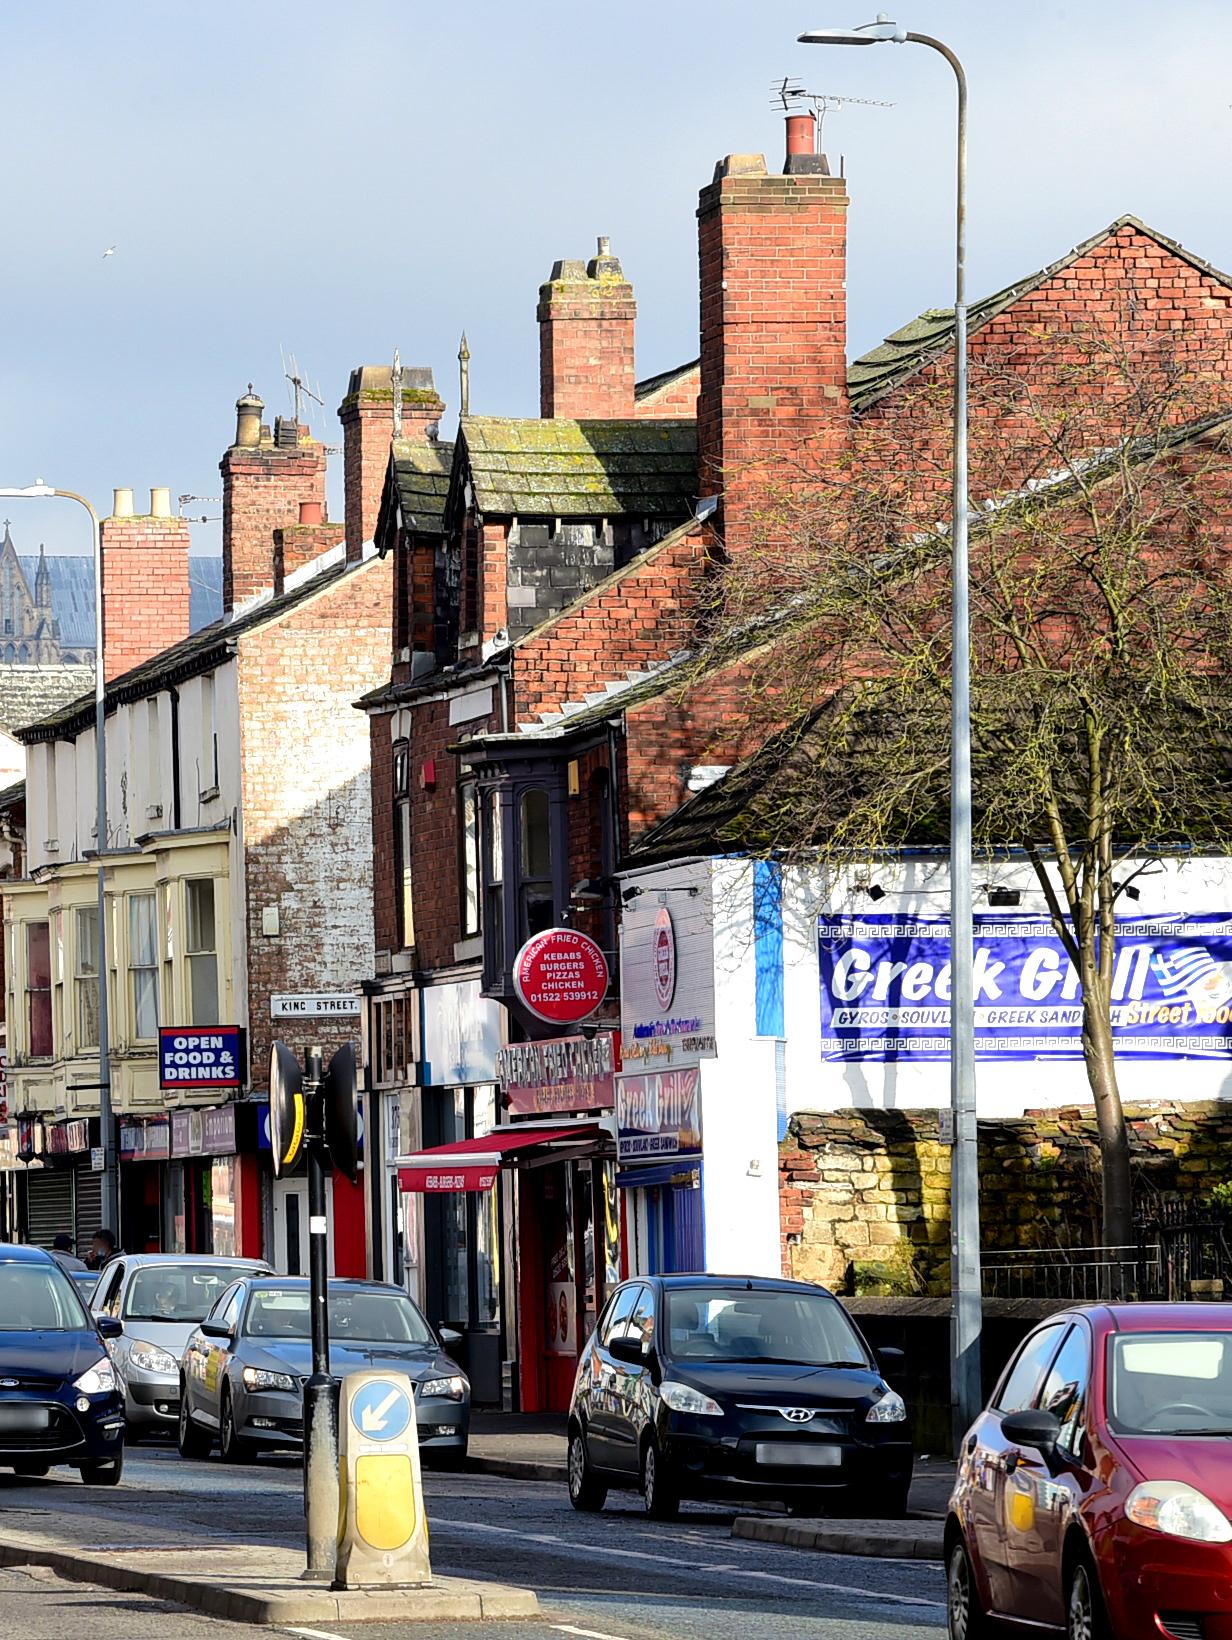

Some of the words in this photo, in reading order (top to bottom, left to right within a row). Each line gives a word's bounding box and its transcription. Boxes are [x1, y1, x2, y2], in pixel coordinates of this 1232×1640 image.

[522, 938, 548, 982] AMERICAN
[551, 934, 579, 944] FRIED
[580, 941, 604, 978] CHICKEN
[543, 952, 582, 961] KEBABS
[540, 962, 585, 971] BURGERS
[546, 971, 581, 980] PIZZAS
[1020, 947, 1154, 1001] Grll
[541, 981, 585, 990] CHICKEN
[530, 993, 561, 1002] 01522
[563, 991, 599, 1000] 539912
[839, 1011, 889, 1024] GYROS
[900, 1010, 976, 1024] SOUVL
[988, 1010, 1036, 1024] GREEK
[1039, 1010, 1121, 1024] SANDH
[1127, 1000, 1193, 1024] Street
[173, 1036, 223, 1049] OPEN
[164, 1051, 215, 1065] FOOD
[219, 1050, 234, 1063] &
[164, 1066, 235, 1080] DRINKS
[618, 1075, 653, 1130] Greek
[655, 1072, 682, 1127] Grill
